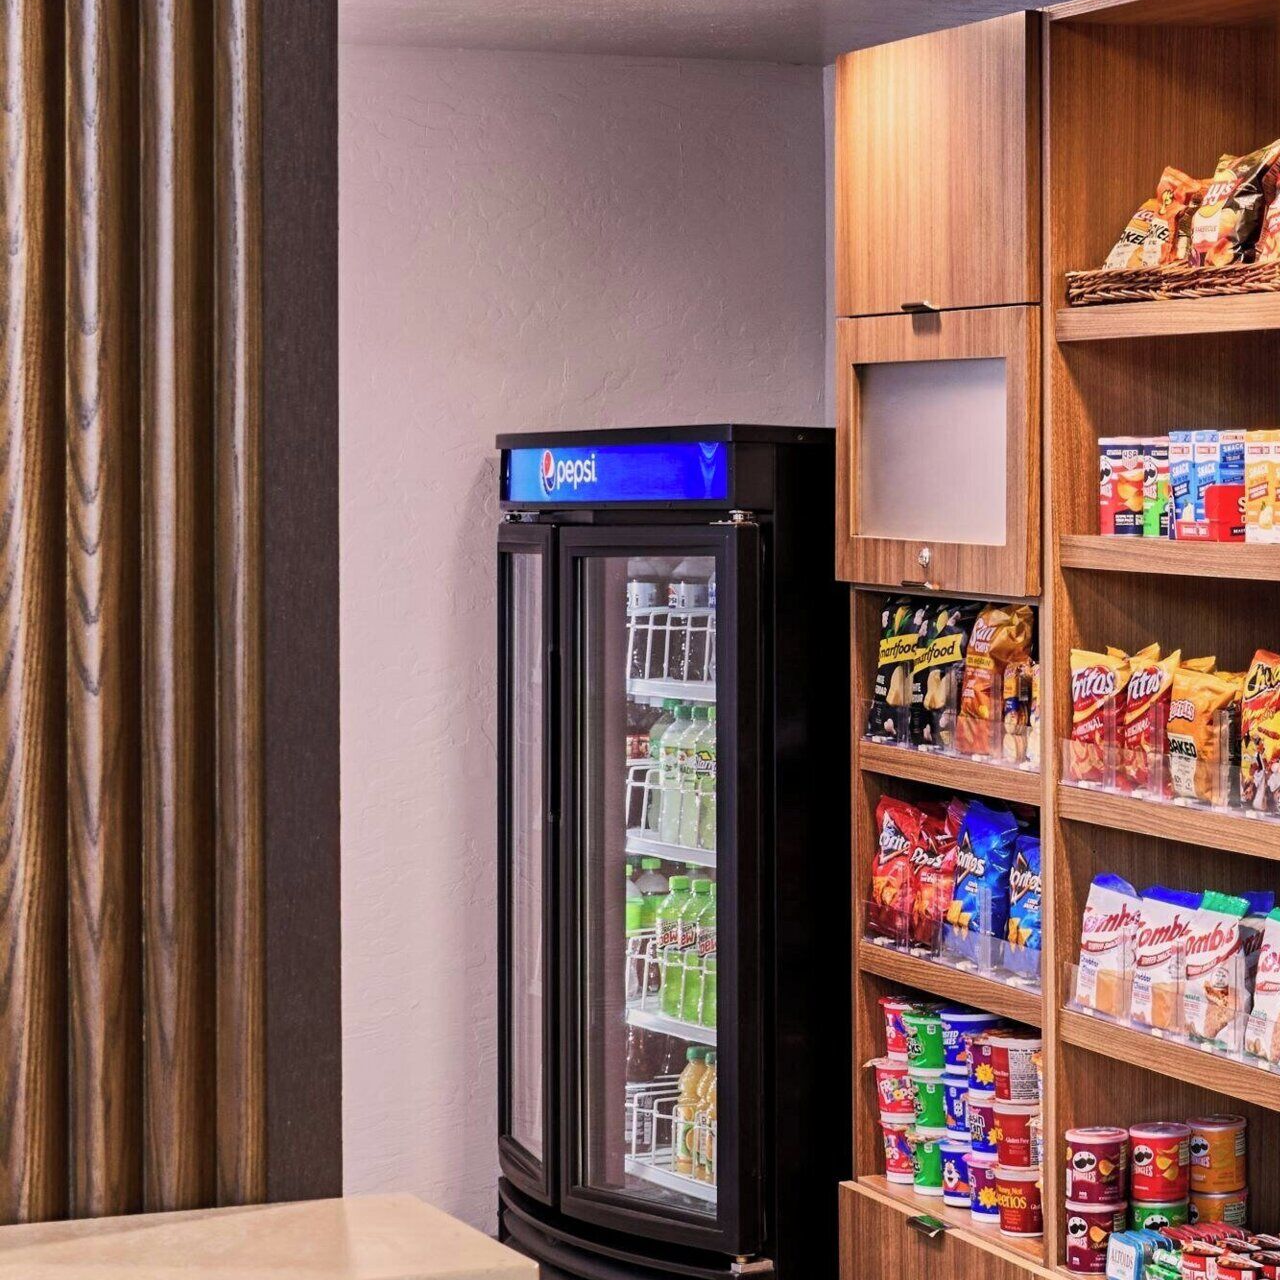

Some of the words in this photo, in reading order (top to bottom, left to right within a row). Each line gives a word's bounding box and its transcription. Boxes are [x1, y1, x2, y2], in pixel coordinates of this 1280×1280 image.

[556, 453, 595, 491] pepsi
[1005, 1136, 1018, 1144] Gluten
[1110, 1248, 1133, 1270] ALTOIDS
